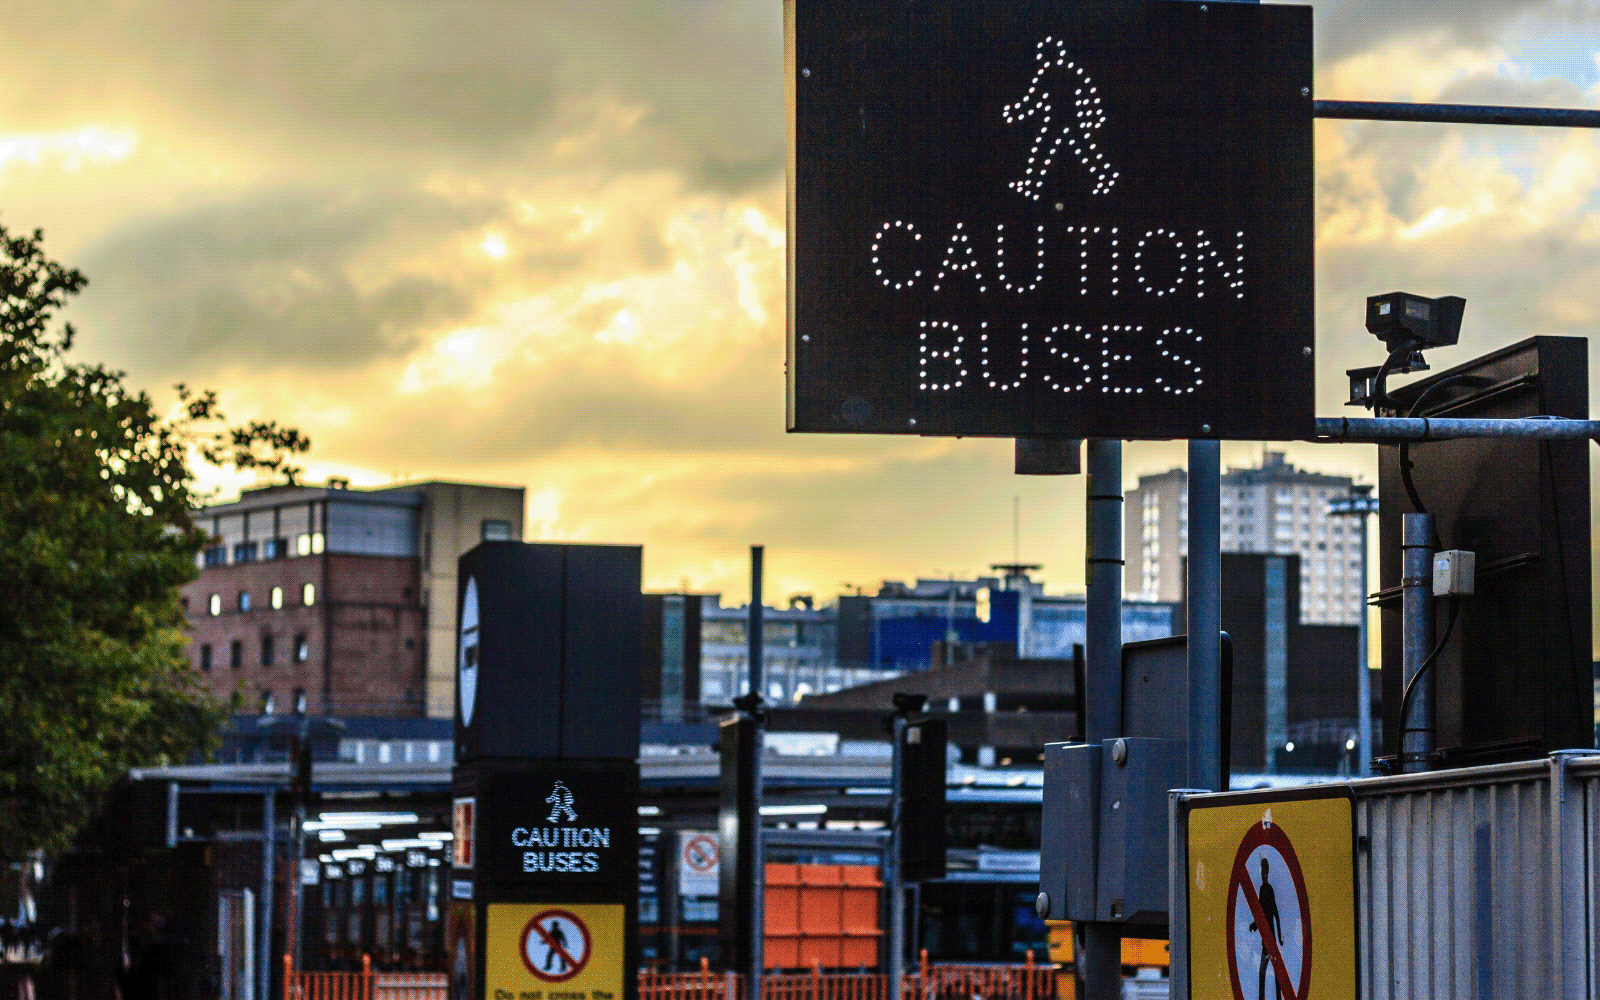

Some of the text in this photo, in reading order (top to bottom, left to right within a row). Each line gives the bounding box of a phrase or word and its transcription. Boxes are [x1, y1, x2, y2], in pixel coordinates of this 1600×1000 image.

[872, 220, 1244, 298] CAUTION
[920, 321, 1203, 395] BUSES
[511, 827, 610, 848] CAUTION
[523, 851, 600, 873] BUSES
